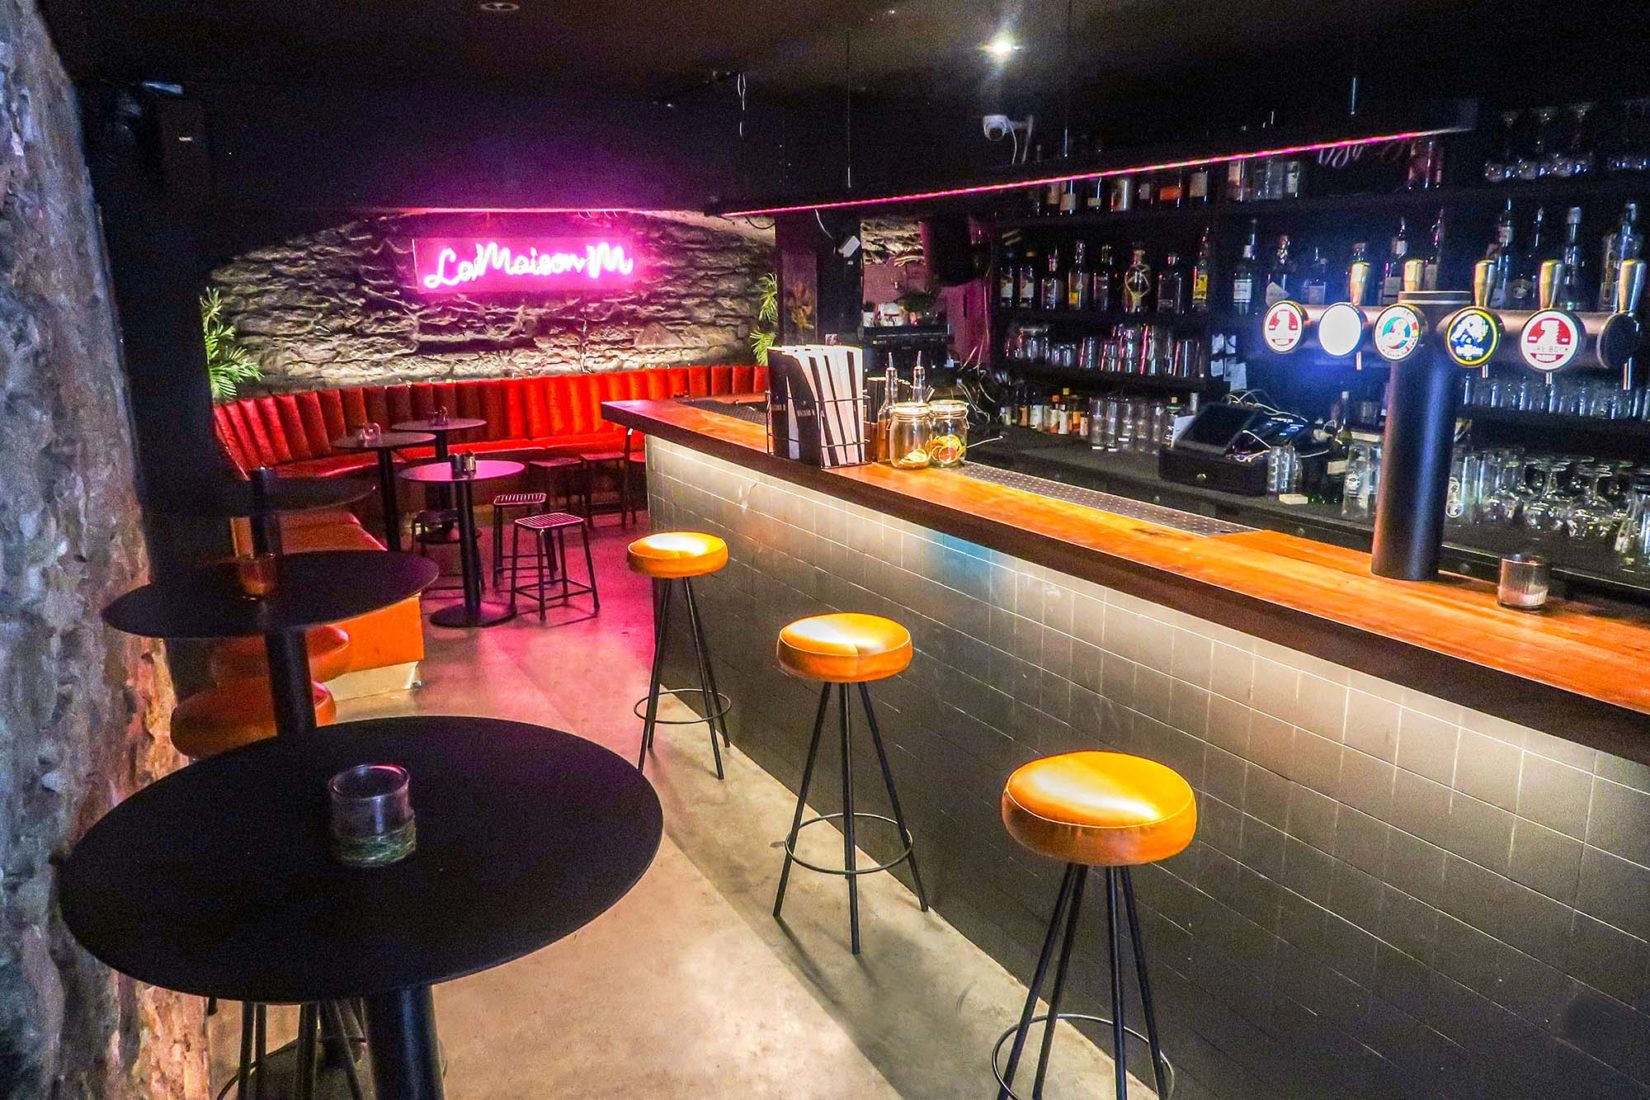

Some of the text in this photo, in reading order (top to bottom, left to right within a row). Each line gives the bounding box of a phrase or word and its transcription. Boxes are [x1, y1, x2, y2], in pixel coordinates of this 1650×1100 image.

[424, 241, 633, 288] La Maison M
